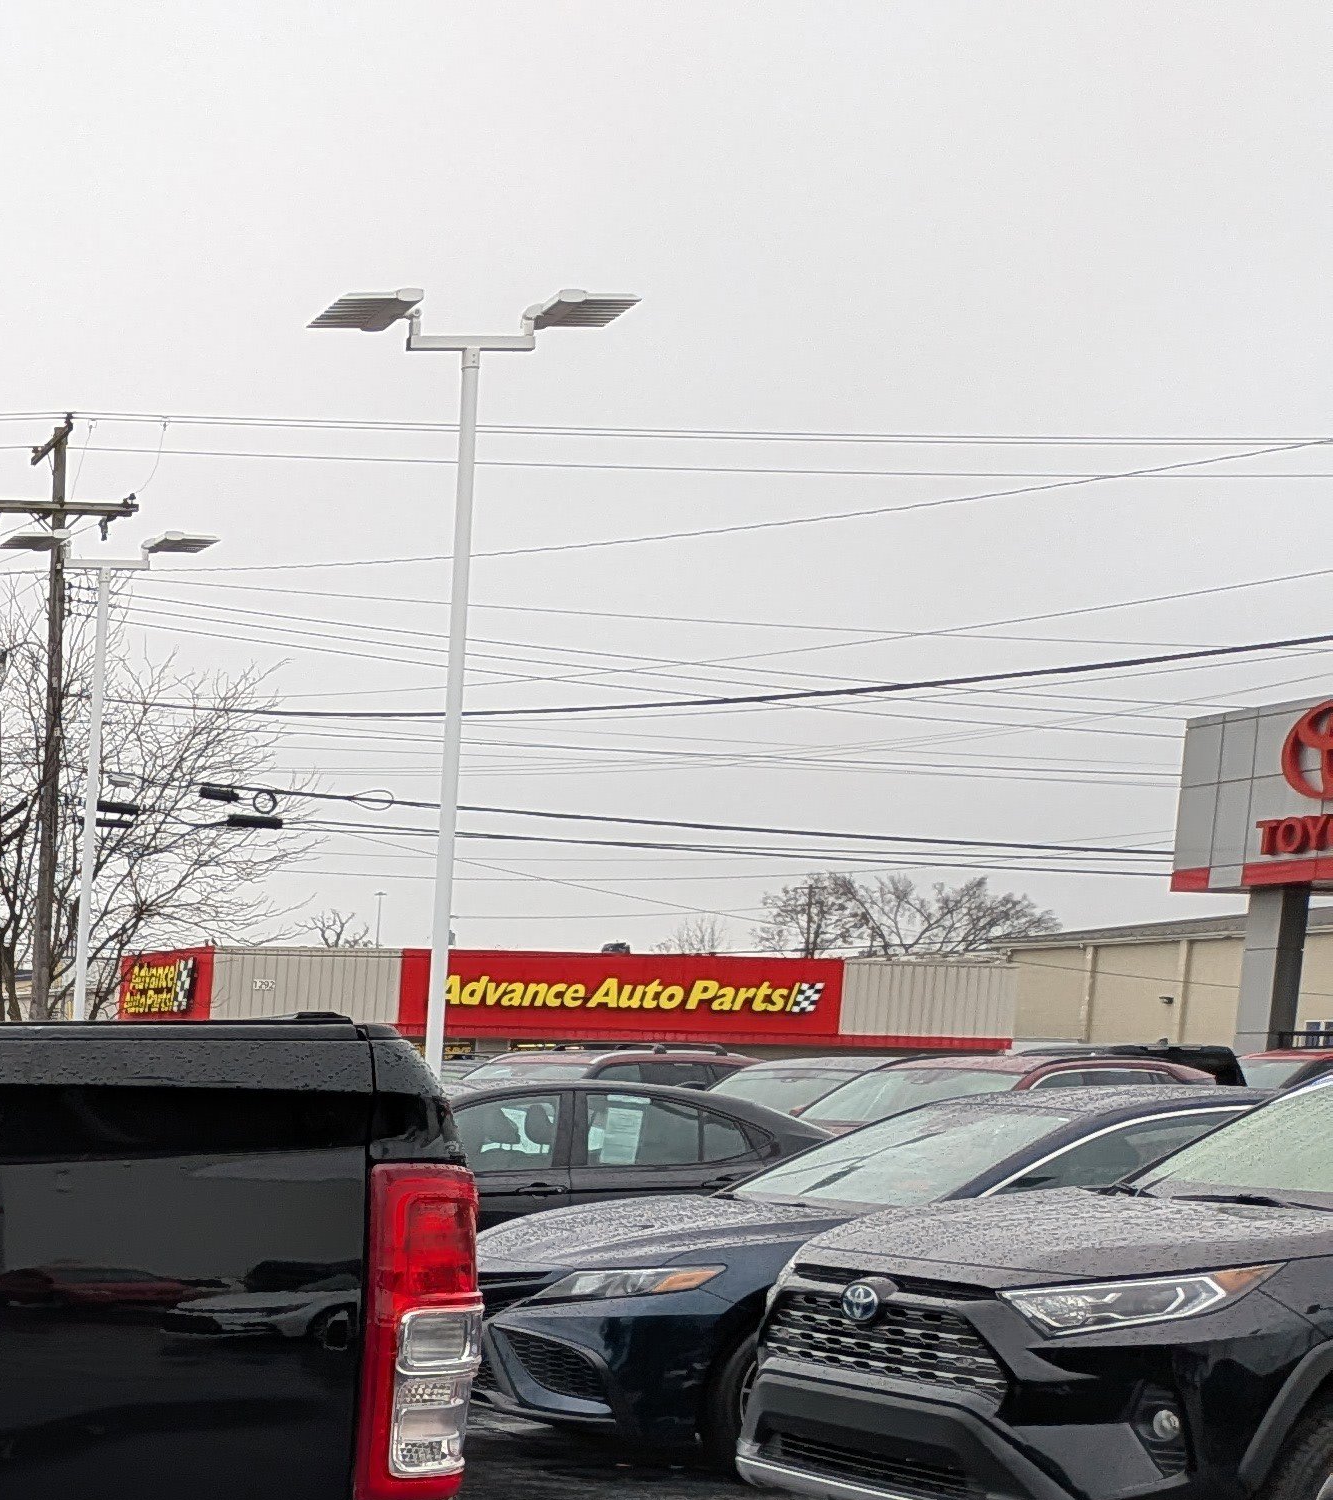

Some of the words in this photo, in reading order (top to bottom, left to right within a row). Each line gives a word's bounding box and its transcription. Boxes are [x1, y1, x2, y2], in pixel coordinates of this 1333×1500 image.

[1256, 813, 1333, 855] TOY
[130, 962, 175, 989] Advance
[253, 979, 276, 990] 1292
[445, 975, 586, 1007] Advance
[585, 977, 685, 1009] Auto
[685, 979, 789, 1012] Parts
